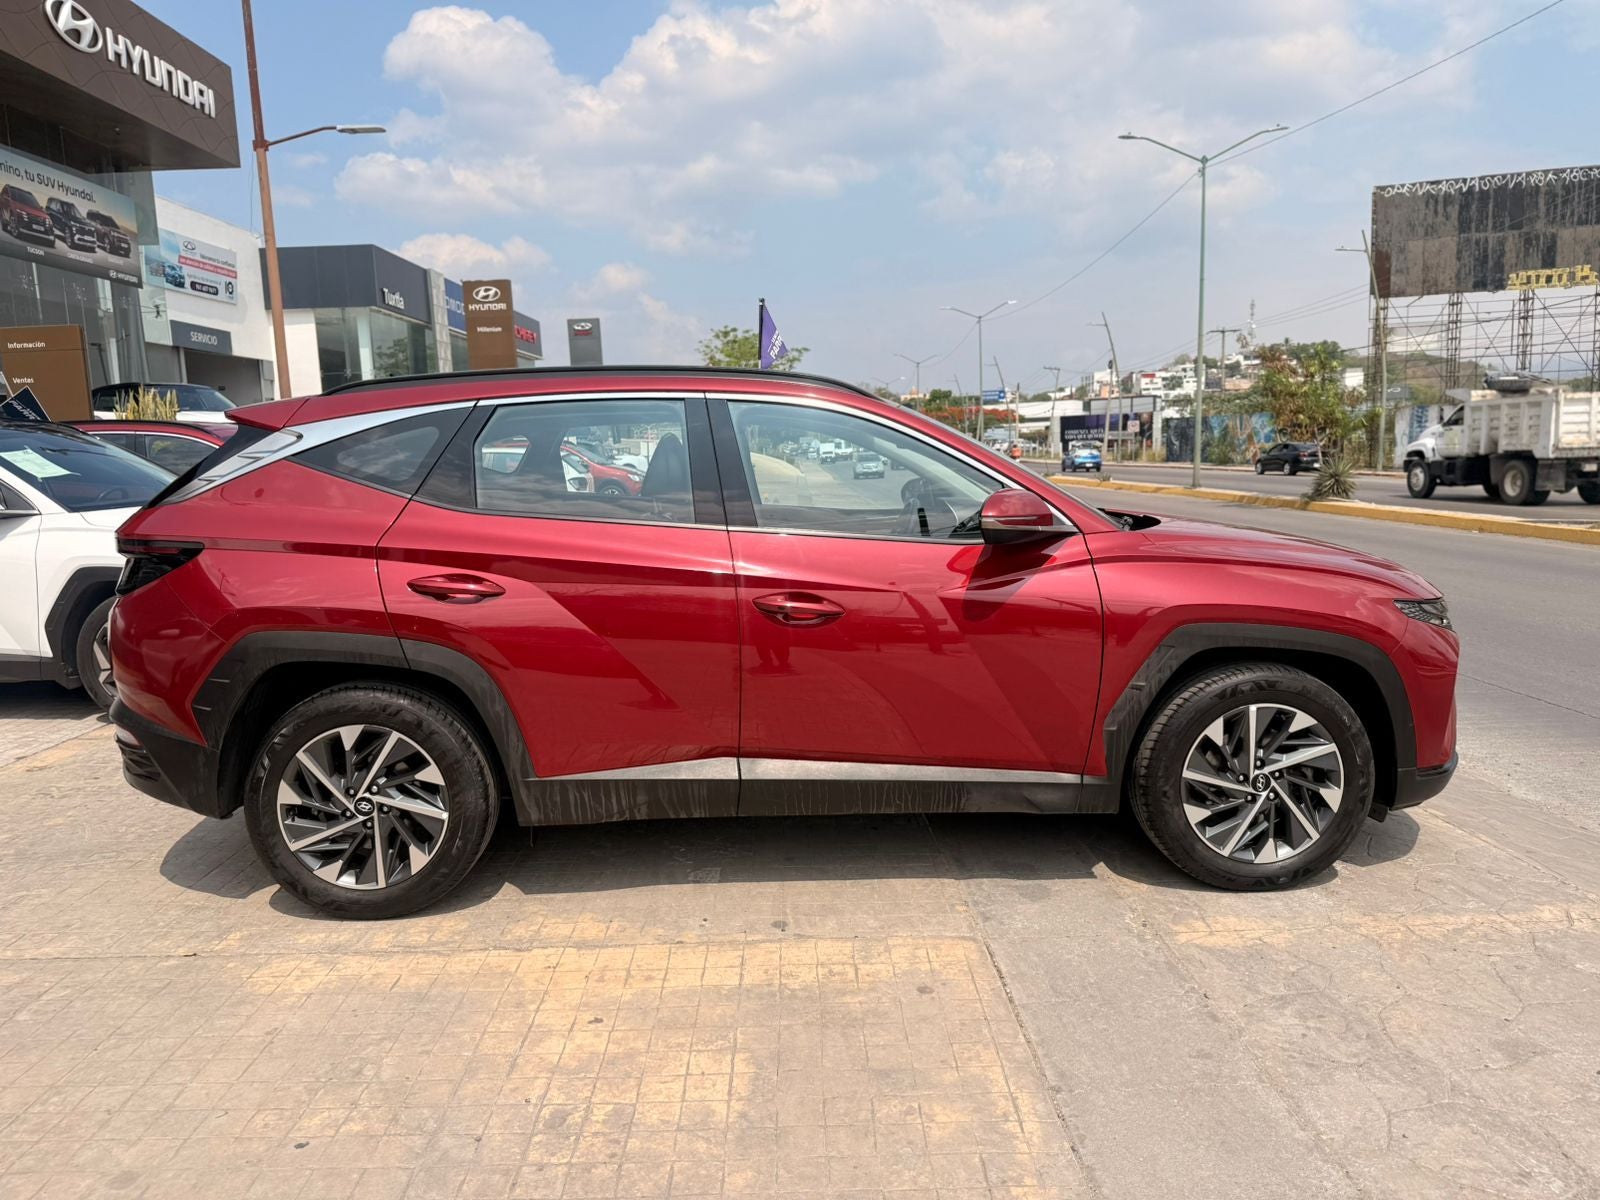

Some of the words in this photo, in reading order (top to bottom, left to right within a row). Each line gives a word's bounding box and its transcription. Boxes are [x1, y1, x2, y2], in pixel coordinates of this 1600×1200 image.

[105, 26, 216, 118] HYUNDAI
[24, 168, 35, 182] tu
[36, 172, 56, 190] SUV
[57, 179, 97, 203] Hyundai.
[26, 246, 45, 257] TUCSON
[383, 288, 405, 309] Tuxtla
[468, 302, 507, 312] HYUNDAI
[7, 341, 46, 349] Información
[190, 331, 218, 346] SERVICIO
